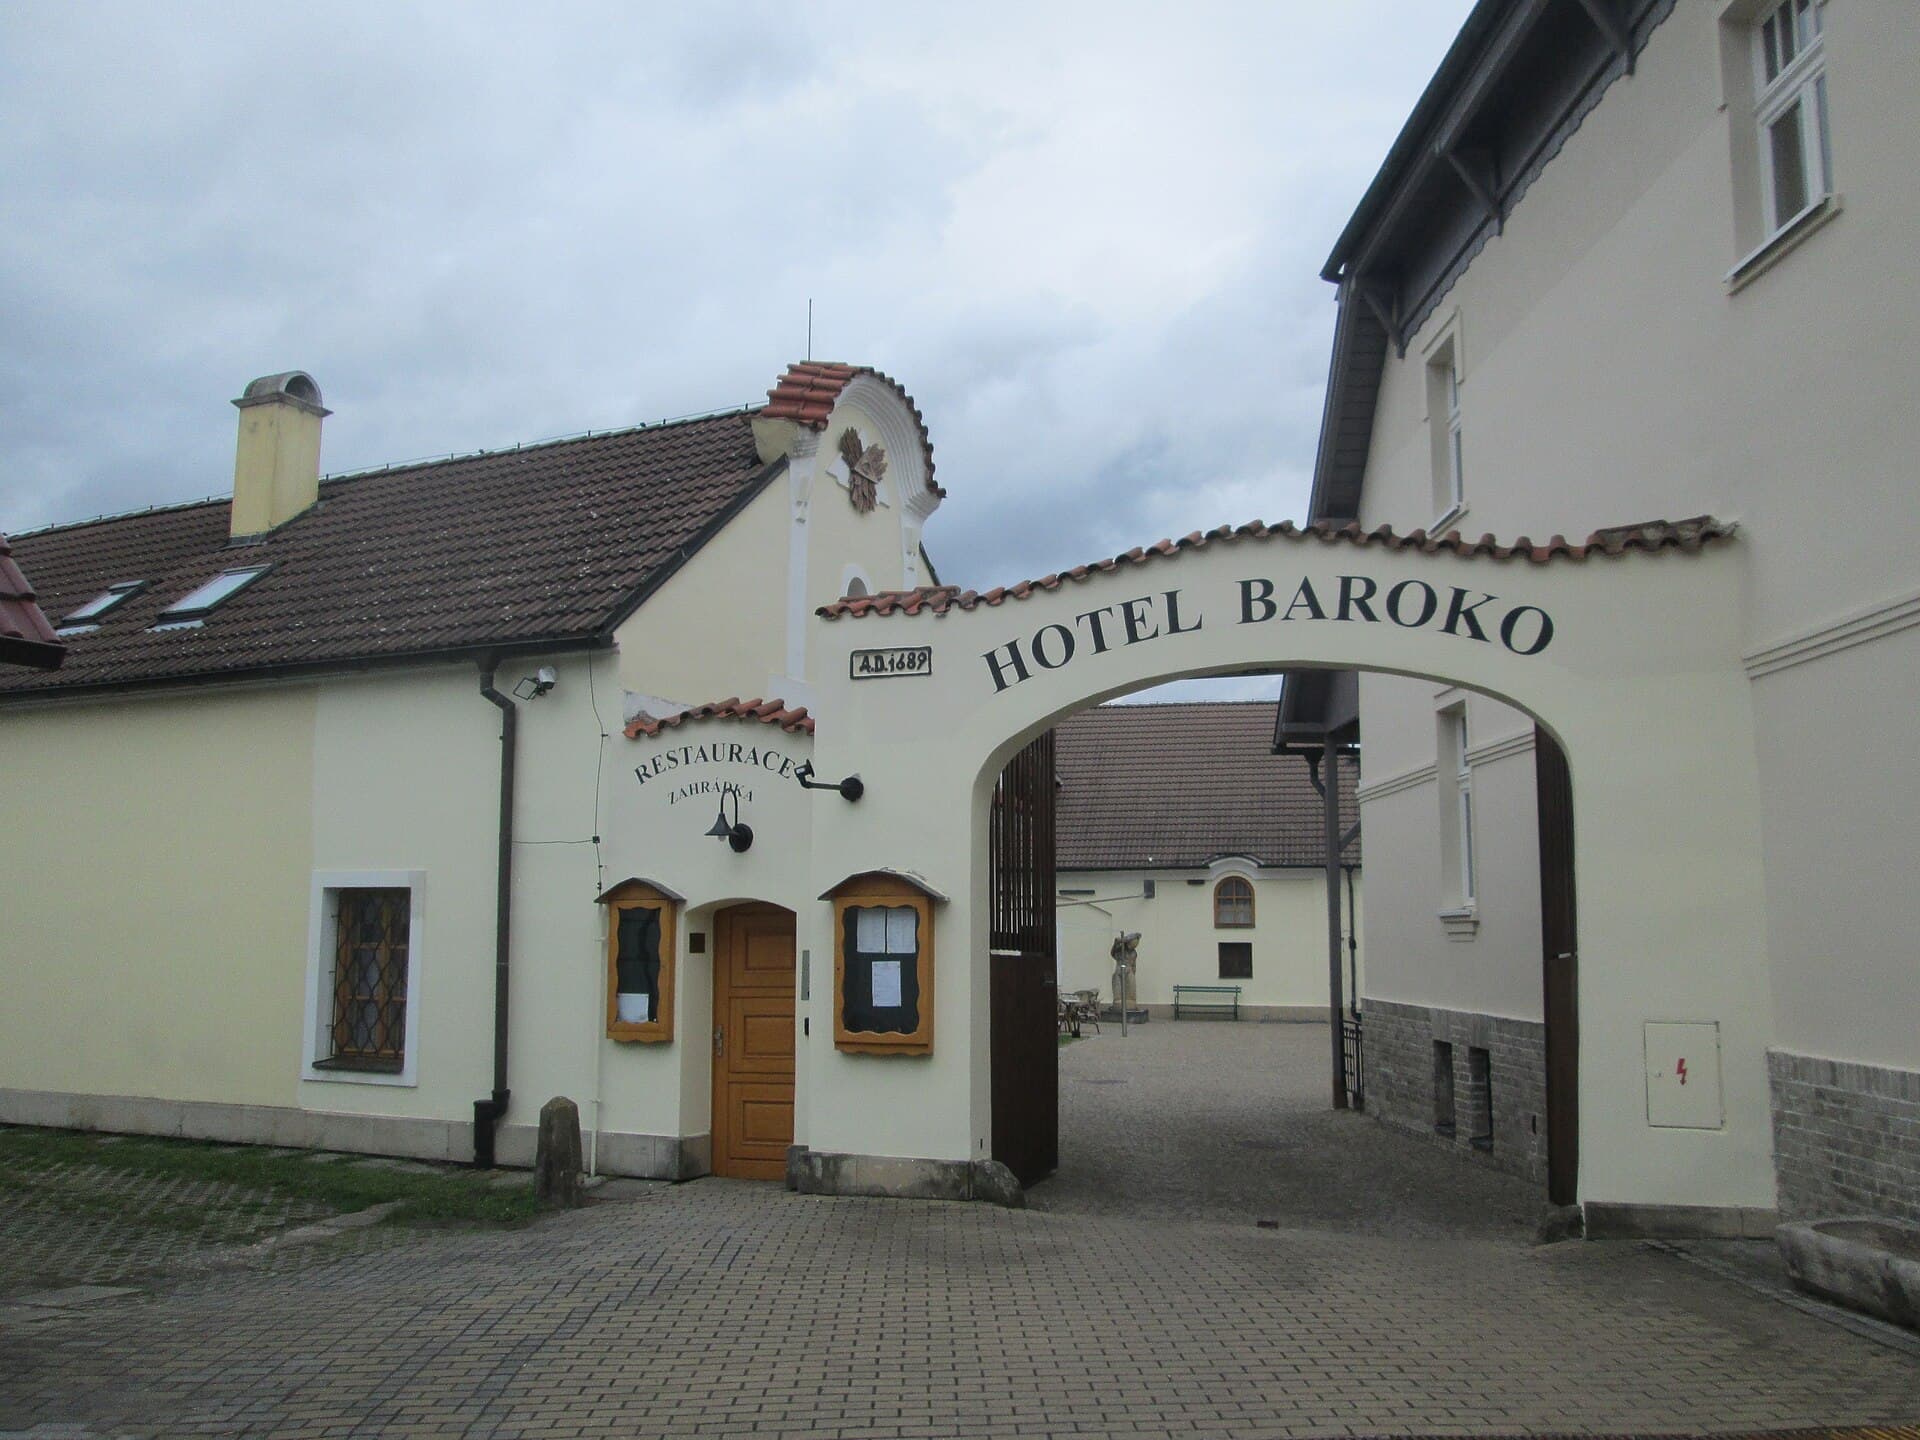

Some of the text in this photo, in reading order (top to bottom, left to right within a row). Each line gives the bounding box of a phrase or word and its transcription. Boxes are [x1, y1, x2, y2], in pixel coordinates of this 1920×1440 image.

[980, 575, 1555, 694] HOTEL BAROKO
[634, 743, 796, 785] RESTAURACE
[668, 777, 753, 805] ZAHRÁDKA
